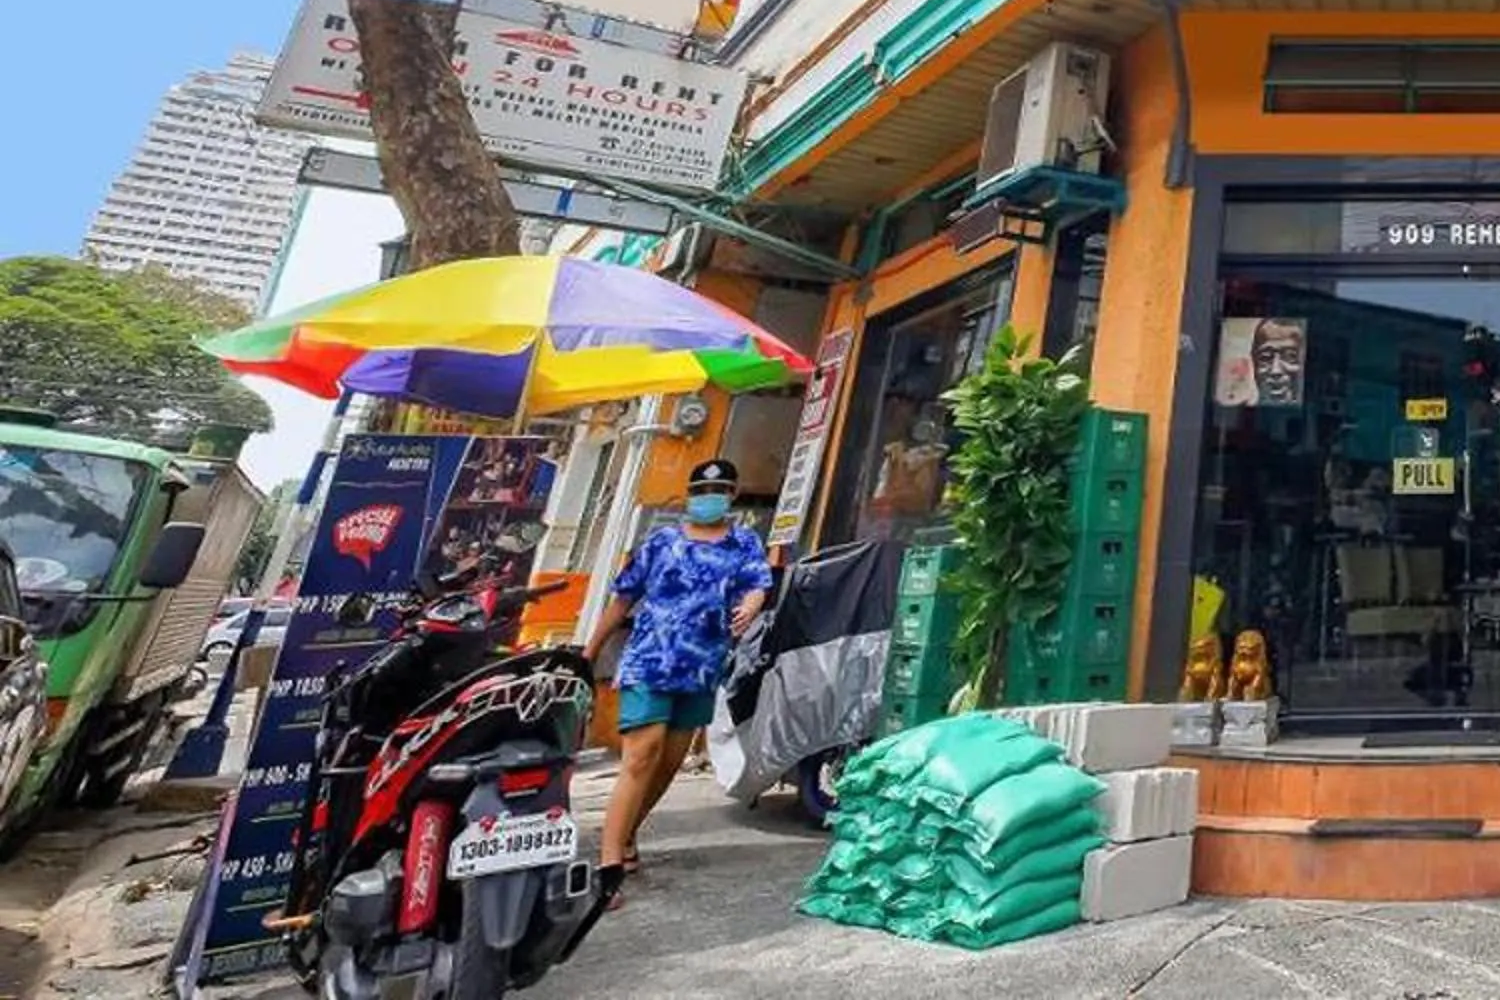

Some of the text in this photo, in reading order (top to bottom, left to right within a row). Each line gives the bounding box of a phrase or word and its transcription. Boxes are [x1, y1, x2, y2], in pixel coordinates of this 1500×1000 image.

[494, 69, 540, 88] 24
[566, 83, 708, 121] HOURS
[504, 50, 588, 80] FOR
[621, 74, 723, 105] RENT
[1388, 223, 1436, 246] 909
[1402, 463, 1446, 487] PULL
